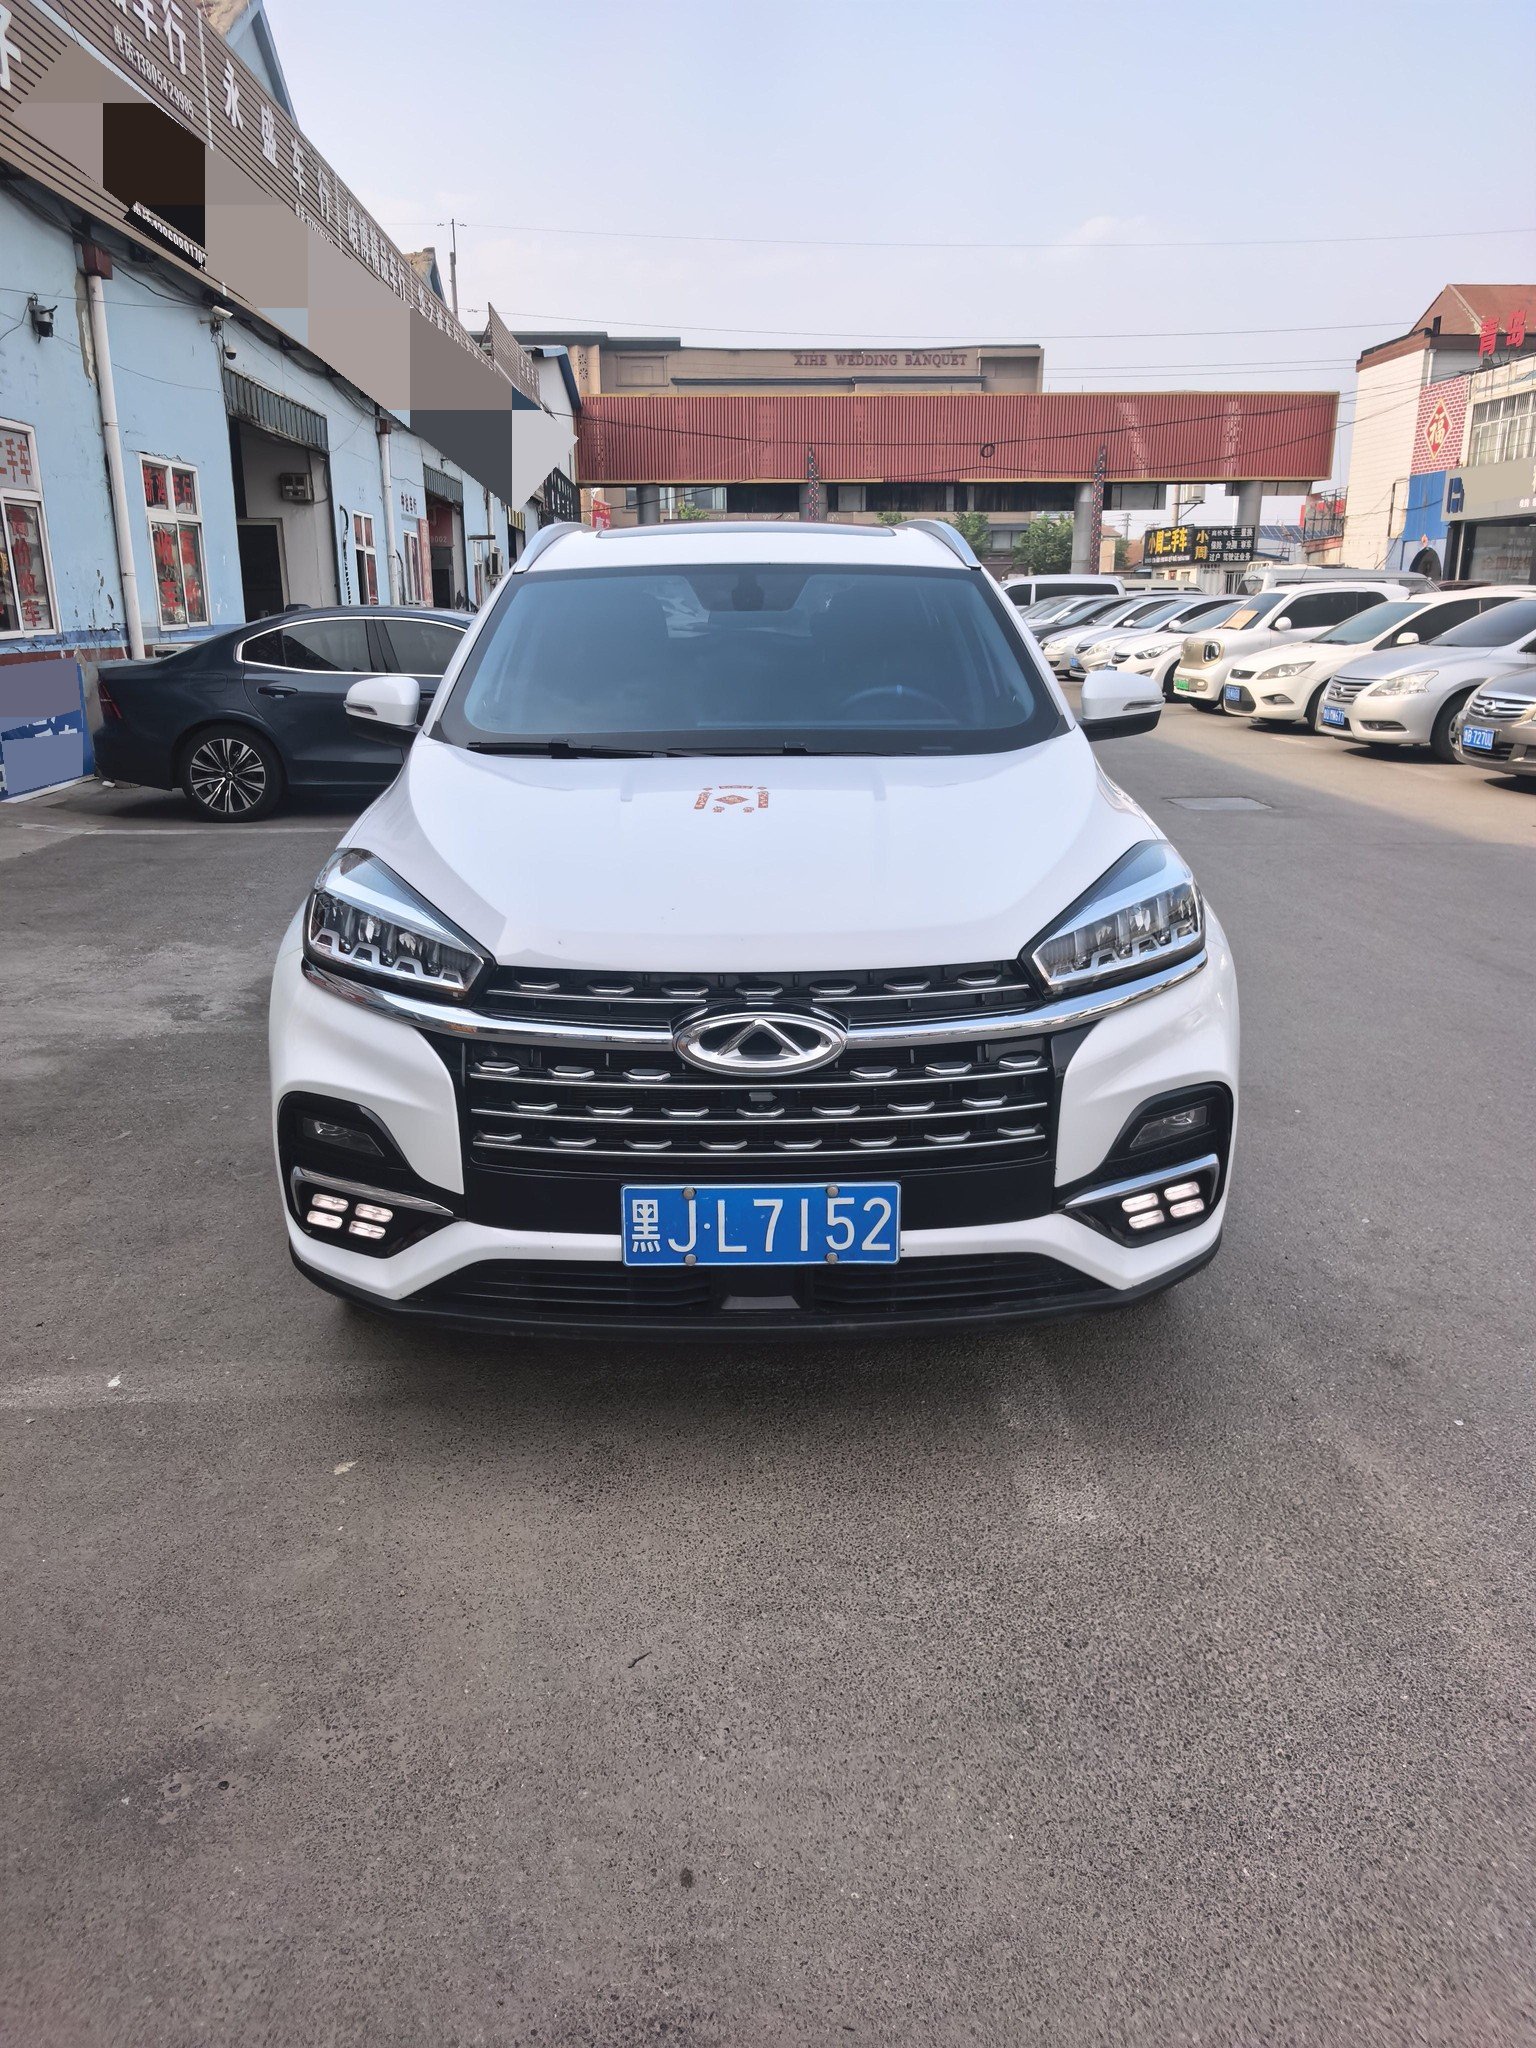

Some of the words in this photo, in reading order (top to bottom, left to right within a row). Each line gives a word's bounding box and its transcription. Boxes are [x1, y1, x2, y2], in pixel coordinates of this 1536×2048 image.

[794, 354, 827, 366] XIHE
[836, 353, 898, 366] WEDDING
[905, 353, 967, 368] BANQUET
[1429, 411, 1446, 446] 福
[1194, 529, 1209, 560] 小周
[632, 1197, 892, 1253] 黑J·L7152
